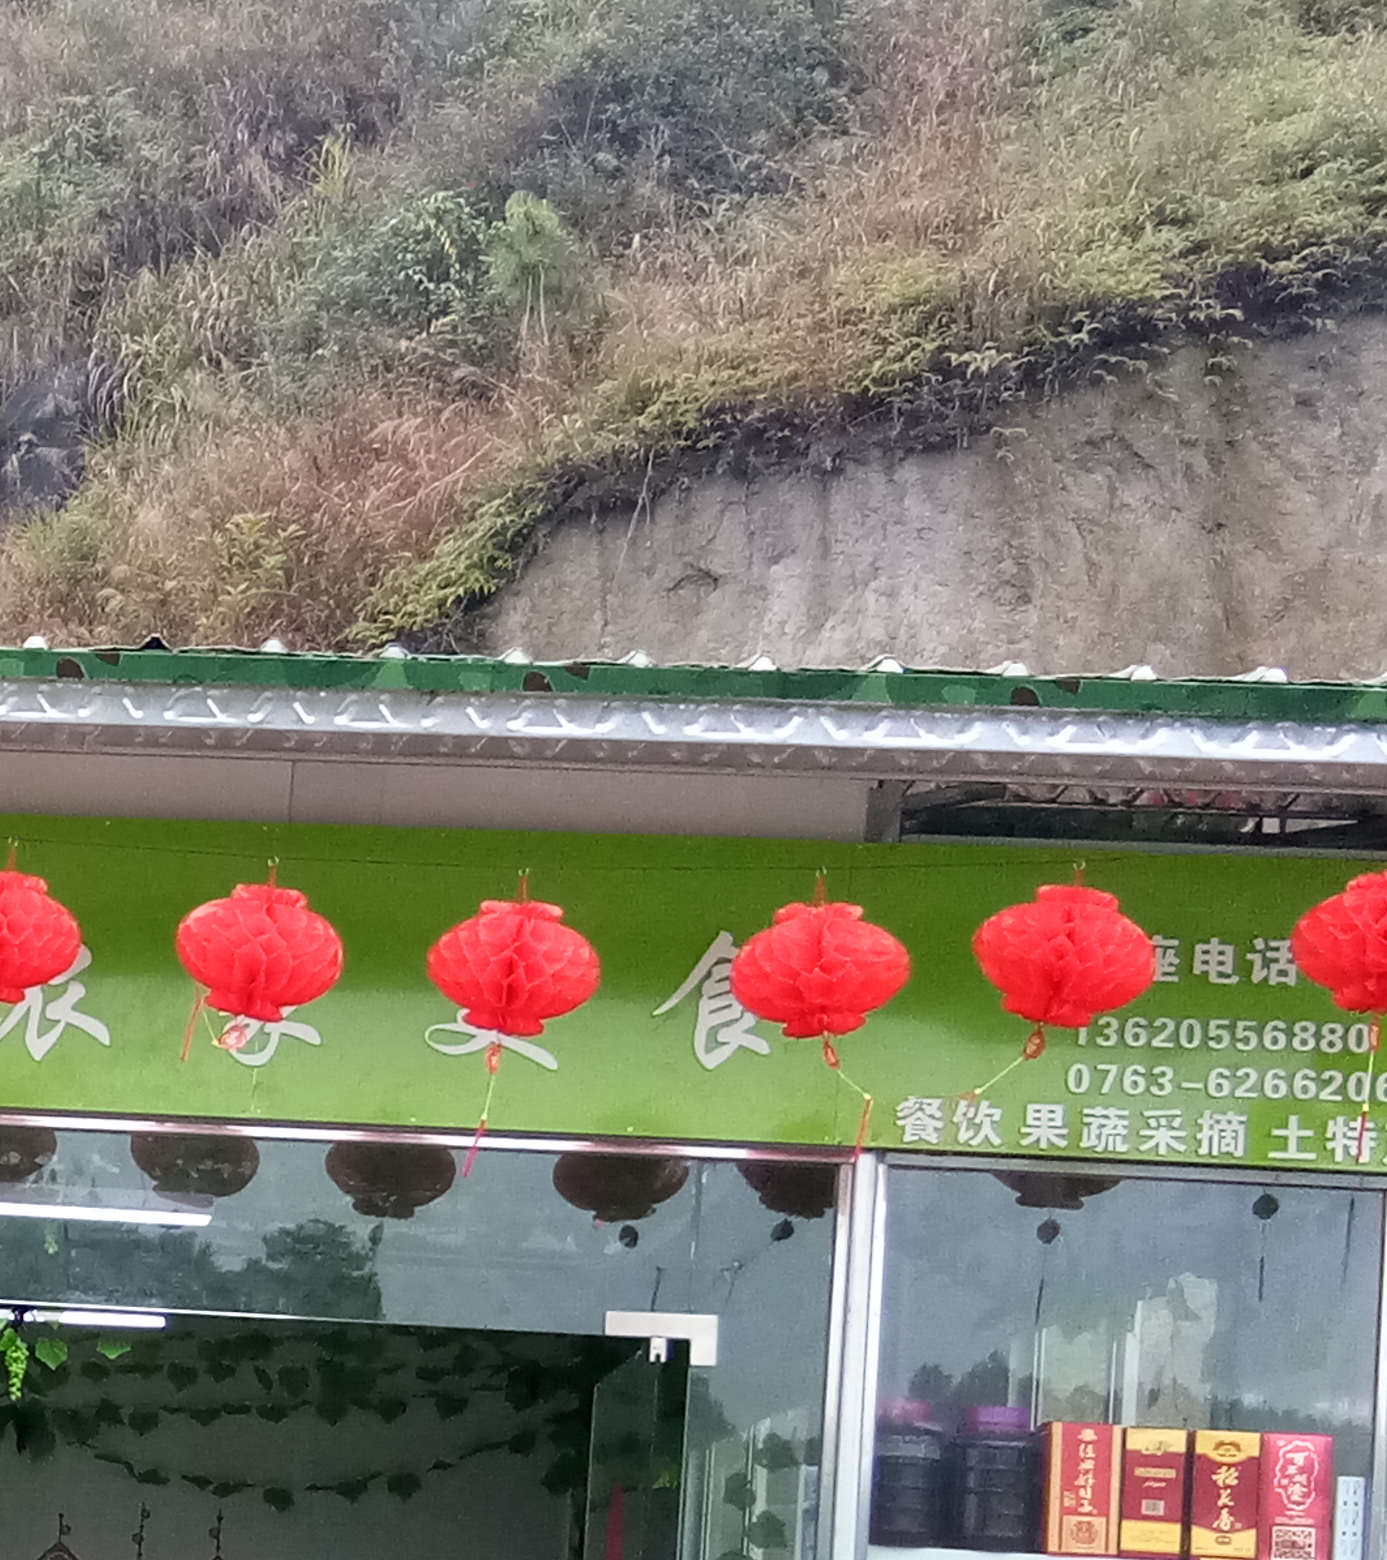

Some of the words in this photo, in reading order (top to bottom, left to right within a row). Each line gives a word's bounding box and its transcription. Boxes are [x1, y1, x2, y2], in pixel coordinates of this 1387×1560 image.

[1077, 1016, 1370, 1054] 13620556880
[895, 1096, 1003, 1146] 餐饮
[1019, 1103, 1248, 1159] 果蔬采摘
[1267, 1114, 1387, 1164] 土特
